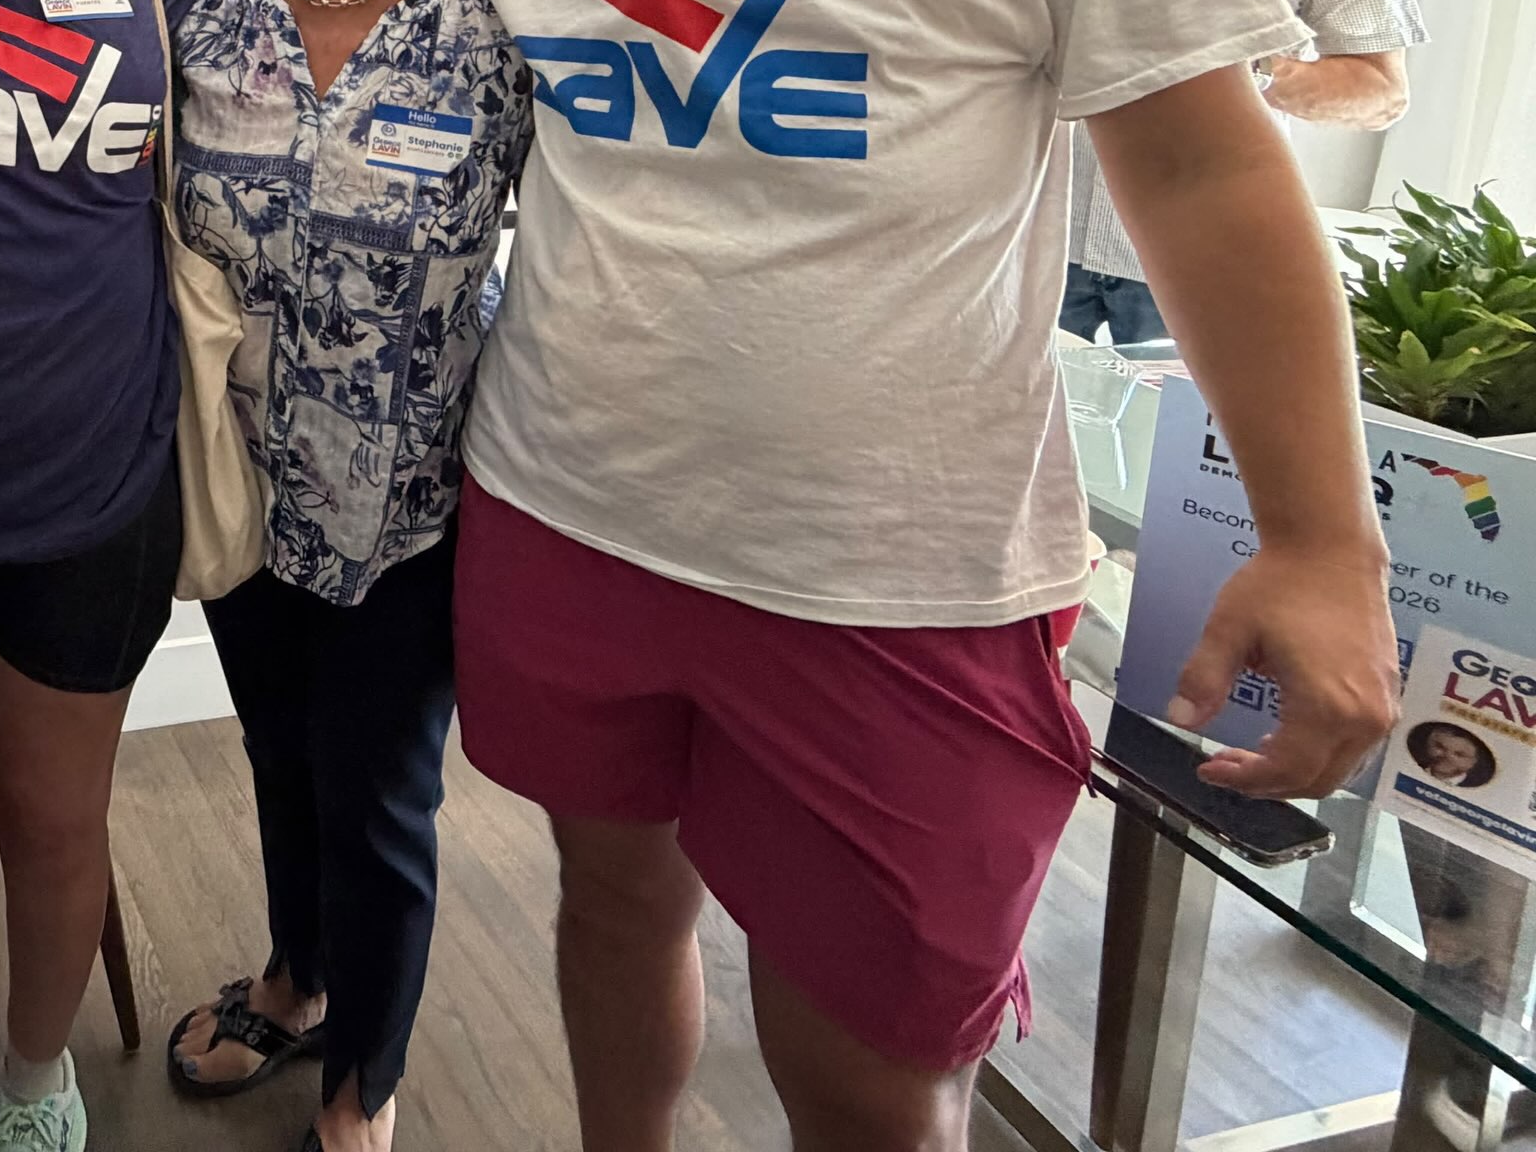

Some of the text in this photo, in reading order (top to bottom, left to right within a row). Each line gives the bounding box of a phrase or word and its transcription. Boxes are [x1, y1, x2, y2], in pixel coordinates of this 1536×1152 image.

[408, 110, 437, 125] Hello
[407, 135, 464, 153] Stephanie
[1389, 585, 1441, 614] 026
[1429, 572, 1511, 606] of the
